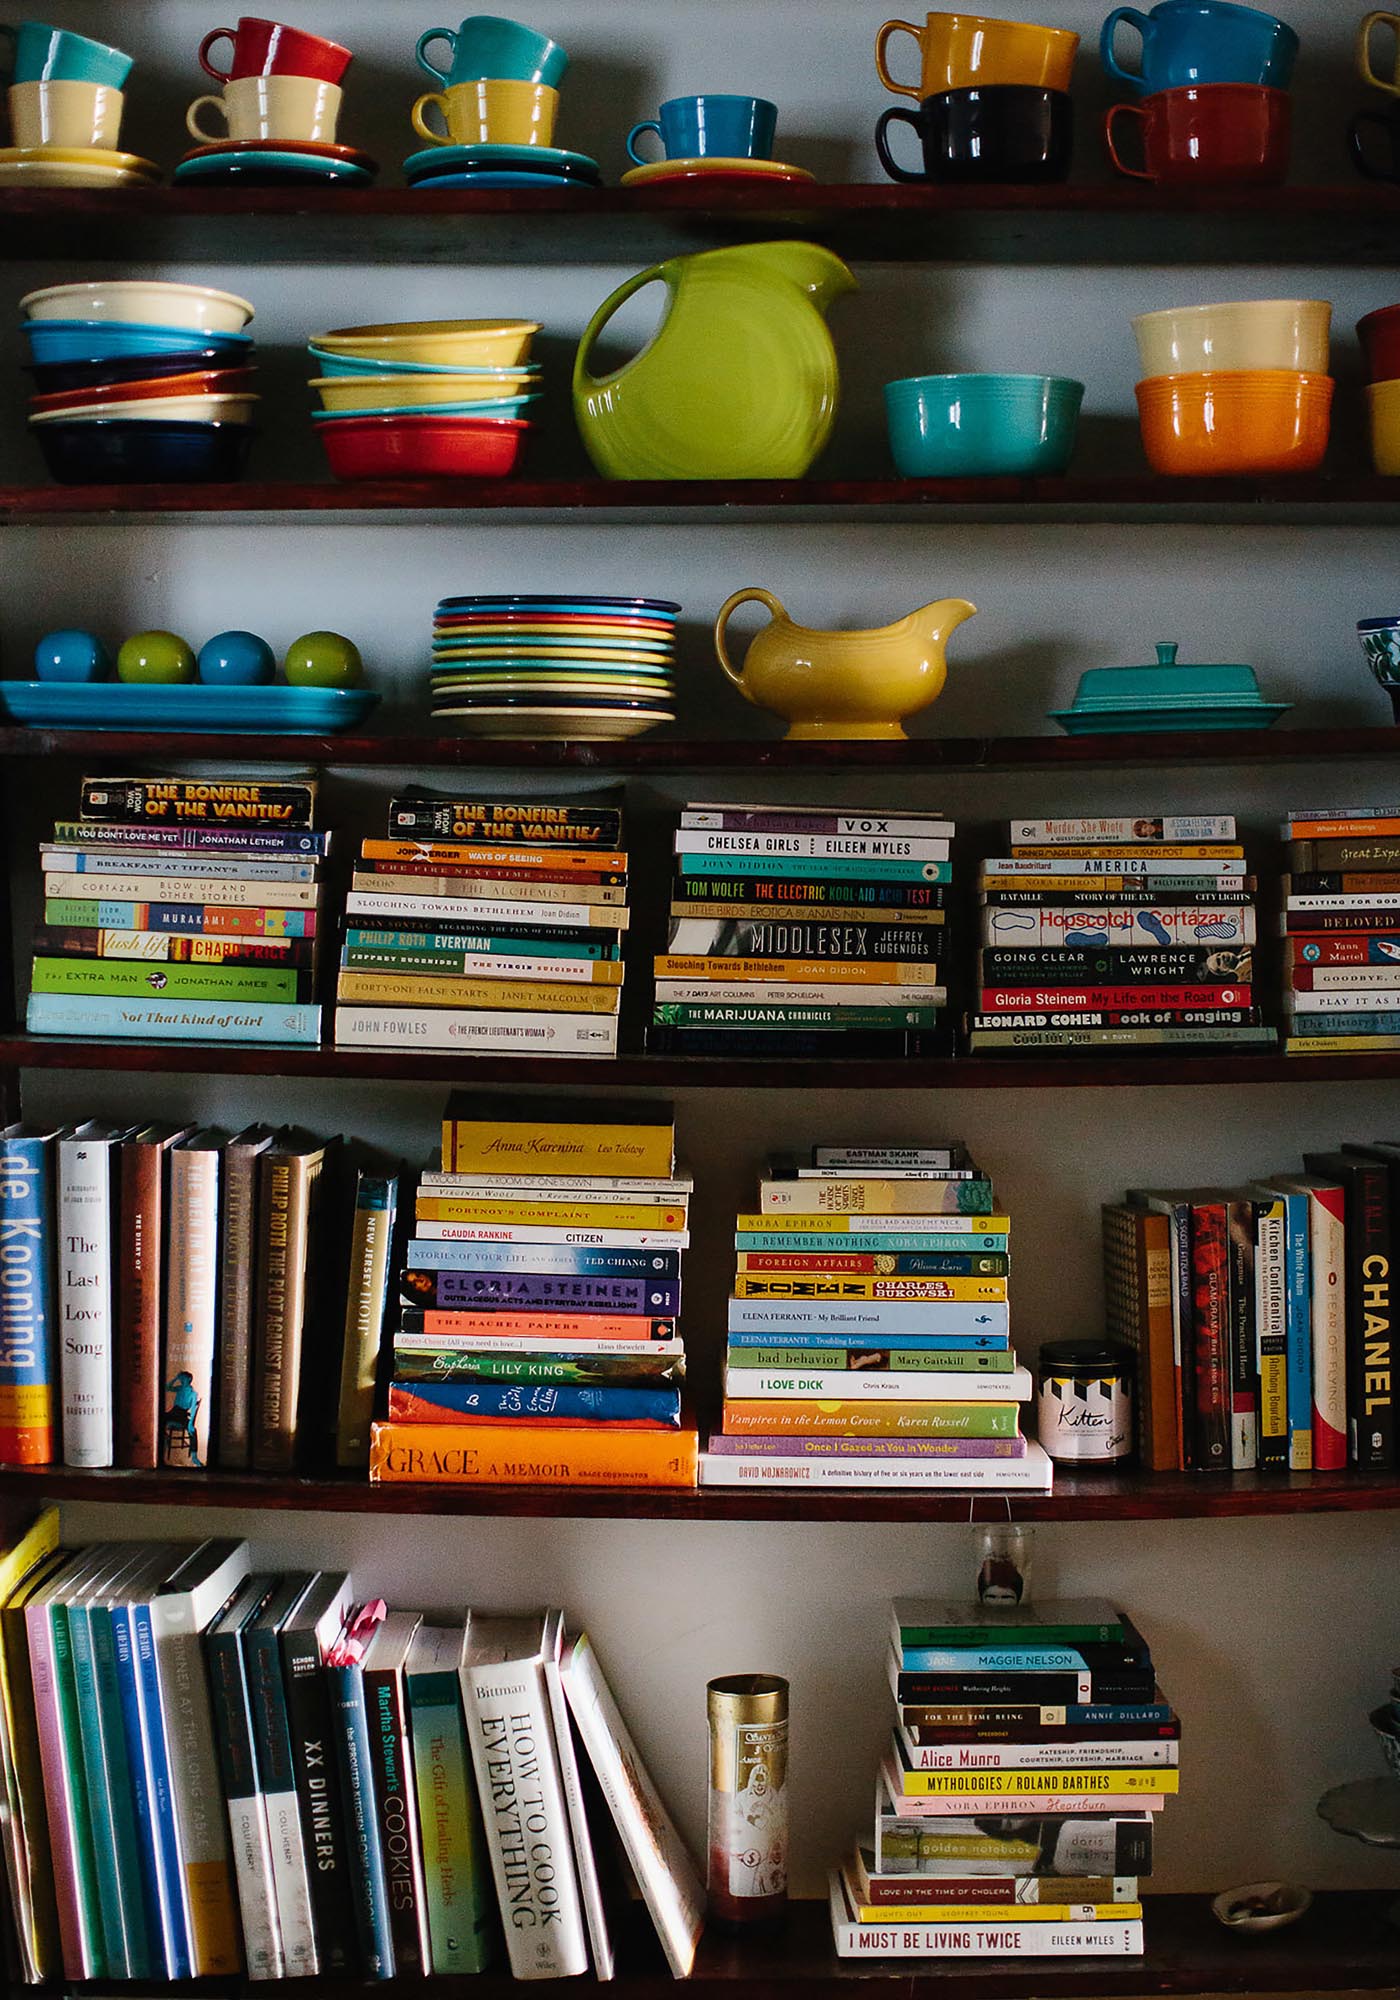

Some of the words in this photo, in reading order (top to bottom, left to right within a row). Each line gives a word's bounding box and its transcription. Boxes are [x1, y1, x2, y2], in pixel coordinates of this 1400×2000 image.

[146, 785, 177, 799] THE
[185, 786, 260, 802] BONFIRE
[146, 801, 168, 815] OF
[176, 803, 206, 816] THE
[213, 803, 293, 818] VANITIES
[454, 805, 486, 819] THE
[493, 807, 568, 822] BONFIRE
[453, 822, 475, 836] OF
[482, 824, 514, 837] THE
[521, 824, 600, 840] VANITIES
[845, 820, 889, 832] VOX
[79, 830, 96, 838] YOU
[98, 831, 123, 841] DON'T
[125, 832, 146, 841] LOVE
[163, 834, 178, 842] YET
[200, 836, 247, 845] JONATHAN
[250, 838, 284, 846] LETHEM
[708, 837, 759, 850] CHELSEA
[766, 838, 800, 851] GIRLS
[826, 841, 866, 853] EILEEN
[872, 842, 910, 854] MYLES
[469, 852, 492, 860] WAYS
[494, 853, 508, 861] OF
[509, 854, 542, 863] SEEING
[96, 860, 161, 870] BREAKFAST
[165, 863, 179, 871] AT
[182, 865, 238, 873] TIFFANY'S
[1084, 860, 1148, 872] AMERICA
[160, 891, 195, 900] OTHER
[201, 893, 245, 902] STORIES
[686, 882, 708, 896] TOM
[712, 882, 744, 898] WOLFE
[357, 900, 416, 910] SLOUCHING
[422, 904, 468, 912] TOWARDS
[473, 906, 534, 916] BETHLEHEM
[162, 914, 225, 925] MURAKAMI
[1040, 912, 1134, 931] Hopscotch
[1150, 910, 1226, 927] Cortázar
[1323, 916, 1395, 928] BELOVED
[434, 936, 490, 950] EVERYMAN
[751, 925, 867, 955] MIDDLESEX
[880, 930, 923, 942] JEFFREY
[104, 933, 139, 950] lush
[143, 932, 169, 960] life
[874, 942, 929, 954] EUGENIDES
[1334, 942, 1358, 951] Yann
[994, 954, 1036, 962] GOING
[1042, 954, 1084, 962] CLEAR
[1120, 954, 1196, 963] LAWRENCE
[1330, 952, 1364, 962] Martel
[666, 960, 705, 970] Slouching
[708, 961, 740, 971] Towards
[744, 962, 785, 972] Bethlehem
[1131, 966, 1186, 975] WRIGHT
[66, 972, 105, 982] EXTRA
[110, 974, 138, 983] MAN
[175, 976, 232, 986] JONATHAN
[237, 979, 267, 988] AMES
[502, 992, 533, 1001] JANET
[537, 993, 588, 1003] MALCOLM
[996, 994, 1032, 1006] Gloria
[1036, 993, 1086, 1005] Steinem
[1376, 997, 1390, 1005] AS
[121, 1010, 143, 1024] Not
[146, 1012, 177, 1024] That
[181, 1013, 214, 1026] Kind
[218, 1014, 232, 1026] of
[233, 1014, 263, 1027] Girl
[974, 1016, 1046, 1028] LEONARD
[1051, 1014, 1102, 1026] COHEN
[352, 1020, 380, 1033] JOHN
[384, 1022, 427, 1034] FOWLES
[482, 1138, 524, 1155] Anna
[525, 1138, 585, 1154] Karenina
[846, 1150, 887, 1158] EASTMAN
[0, 1156, 39, 1198] de
[441, 1229, 476, 1239] CLAUDIA
[479, 1229, 513, 1240] RANKINE
[566, 1233, 603, 1244] CITIZEN
[1269, 1220, 1280, 1262] Kitchen
[67, 1237, 97, 1252] The
[584, 1258, 603, 1266] TED
[607, 1257, 647, 1268] CHIANG
[758, 1258, 809, 1268] FOREIGN
[815, 1258, 863, 1268] AFFAIRS
[67, 1271, 99, 1287] Last
[876, 1281, 944, 1290] CHARLES
[0, 1218, 44, 1367] Kooning
[443, 1279, 530, 1293] GLORIA
[544, 1281, 639, 1297] STEINEM
[746, 1281, 865, 1296] WOMEN
[876, 1289, 955, 1298] BUKOWSKI
[1270, 1265, 1282, 1334] Confidential
[66, 1304, 101, 1320] Love
[743, 1313, 769, 1321] ELENA
[771, 1313, 813, 1321] FERRANTE
[741, 1335, 767, 1345] ELENA
[769, 1336, 809, 1345] FERRANTE
[1362, 1255, 1391, 1416] CHANEL
[66, 1338, 103, 1355] Song
[757, 1352, 780, 1364] bad
[785, 1353, 839, 1365] behavior
[898, 1355, 920, 1366] Mary
[923, 1355, 963, 1366] Gaitskill
[492, 1363, 524, 1374] LILY
[528, 1364, 564, 1376] KING
[761, 1379, 764, 1390] I
[767, 1380, 795, 1390] LOVE
[798, 1380, 823, 1390] DICK
[897, 1416, 928, 1427] Karen
[930, 1416, 969, 1427] Russell
[1059, 1405, 1113, 1427] Kitten
[387, 1448, 480, 1475] GRACE
[488, 1464, 499, 1475] A
[504, 1463, 570, 1477] MEMOIR
[979, 1656, 1022, 1665] MAGGIE
[1026, 1655, 1072, 1664] NELSON
[476, 1684, 527, 1699] Bittman
[377, 1686, 391, 1732] Martha
[1119, 1711, 1160, 1719] DILLARD
[304, 1740, 323, 1767] XX
[509, 1713, 540, 1782] HOW
[382, 1734, 397, 1791] Stewart's
[920, 1750, 952, 1767] Alice
[960, 1750, 1001, 1766] Munro
[927, 1777, 1002, 1791] MYTHOLOGIES
[1017, 1777, 1059, 1790] ROLAND
[1062, 1776, 1110, 1790] BARTHES
[523, 1792, 548, 1832] TO
[309, 1778, 335, 1871] DINNERS
[480, 1717, 537, 1929] EVERYTHING
[384, 1797, 414, 1909] COOKIES
[923, 1844, 967, 1856] golden
[972, 1844, 1031, 1854] notebook
[530, 1845, 562, 1925] COOK
[849, 1933, 853, 1948] I
[859, 1933, 898, 1948] MUST
[904, 1933, 920, 1948] BE
[926, 1933, 971, 1948] LIVING
[976, 1933, 1021, 1948] TWICE
[1052, 1936, 1082, 1945] EILEEN
[1085, 1935, 1114, 1945] MYLES
